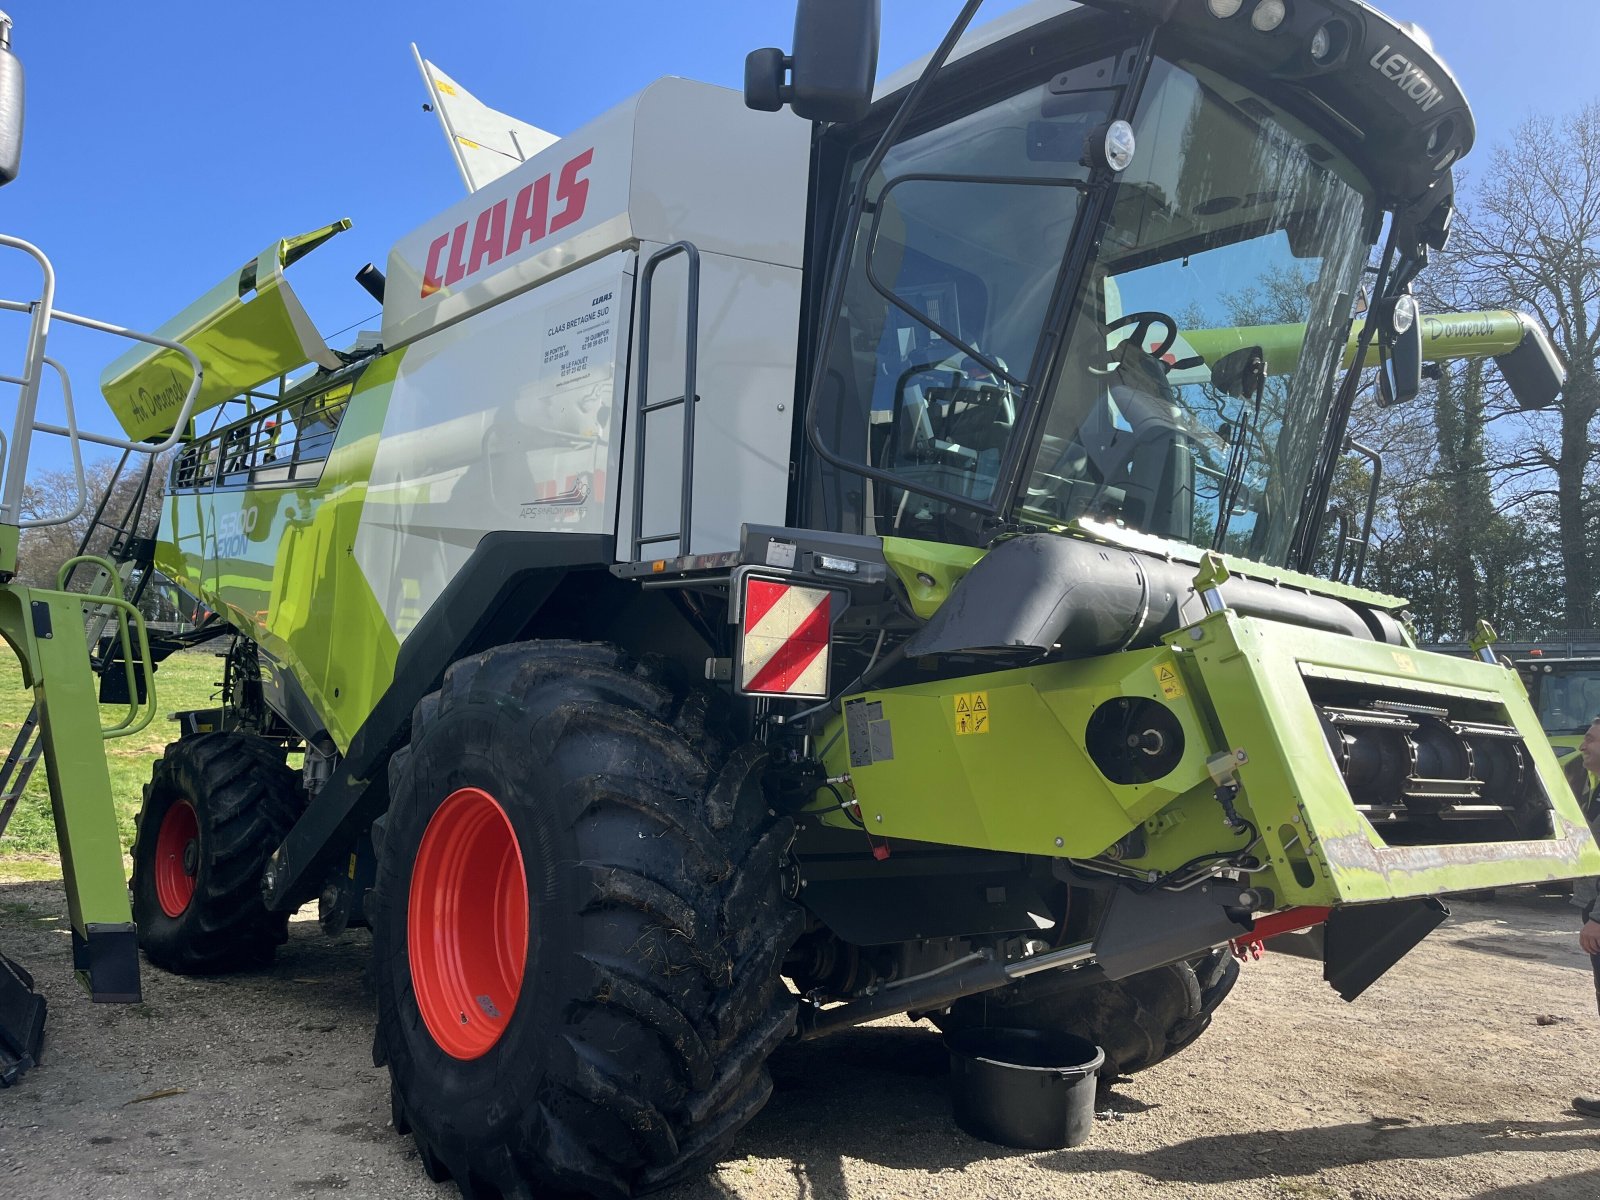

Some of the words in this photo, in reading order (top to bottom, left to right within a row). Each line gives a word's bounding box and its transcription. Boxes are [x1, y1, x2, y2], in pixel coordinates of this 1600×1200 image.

[1369, 44, 1444, 112] LEXION
[420, 146, 594, 299] CLAAS
[592, 292, 613, 306] CLAAS
[547, 323, 566, 337] CLAAS
[566, 311, 596, 330] BRETAGNE
[596, 306, 610, 318] SUD
[590, 329, 610, 341] QUIMPER
